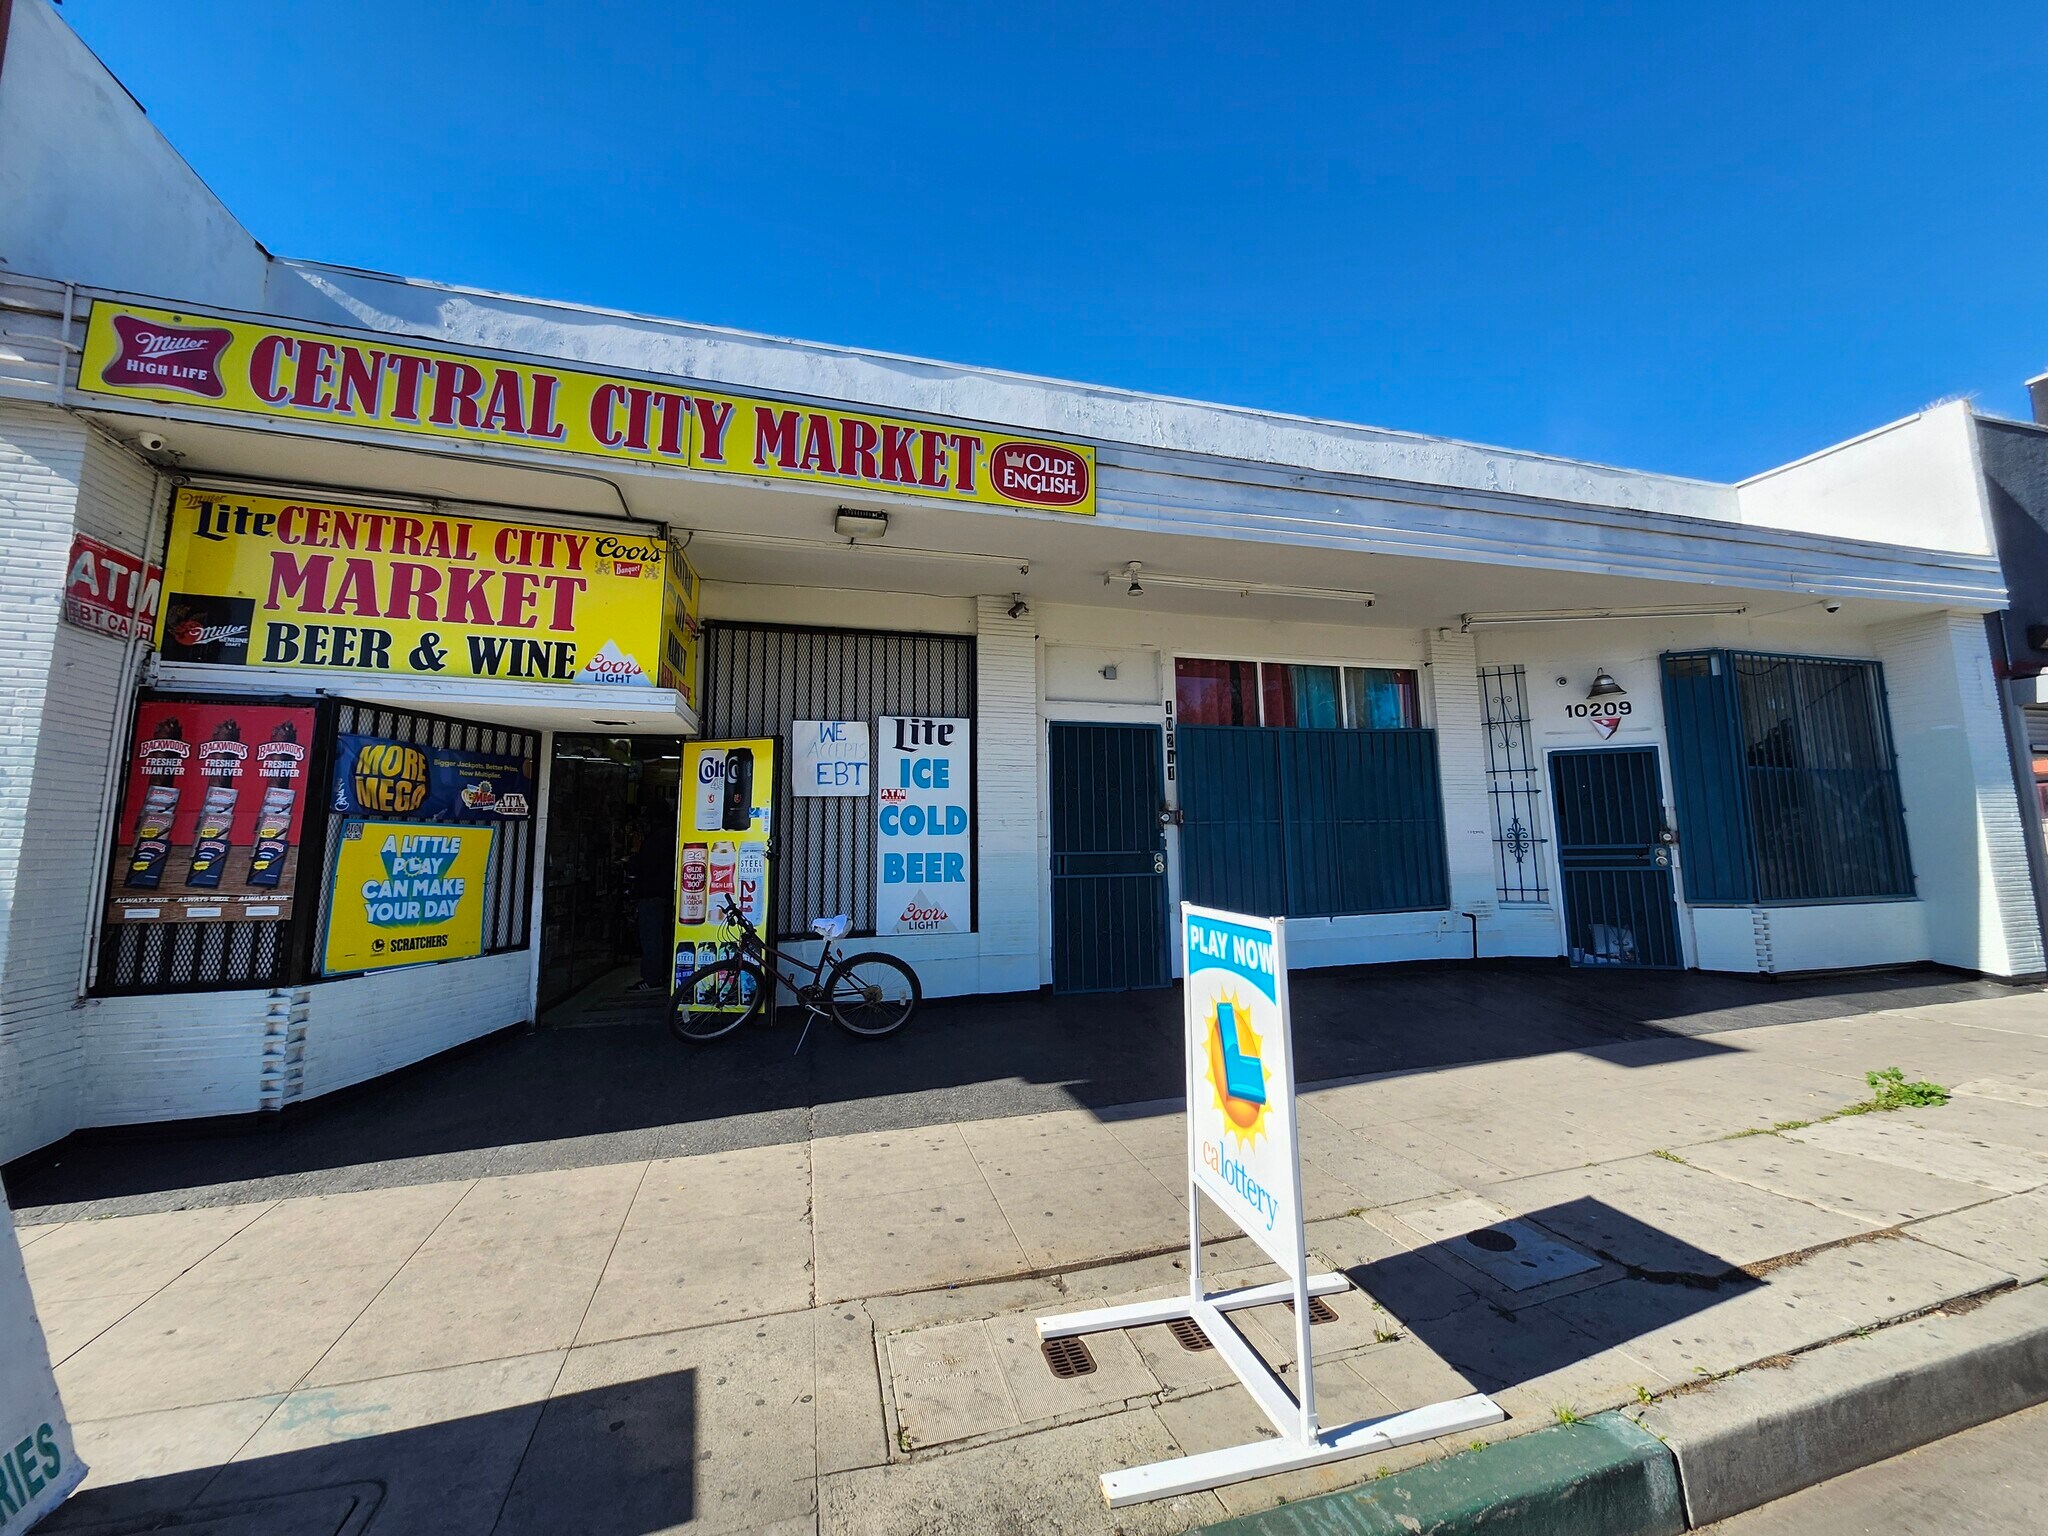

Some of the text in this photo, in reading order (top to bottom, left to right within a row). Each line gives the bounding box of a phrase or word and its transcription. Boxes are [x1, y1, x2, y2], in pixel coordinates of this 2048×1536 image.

[135, 331, 210, 360] Miller
[126, 360, 209, 381] HIGH LIFE
[248, 335, 982, 492] CENTRAL CITY MARKET
[1025, 453, 1076, 477] OLDE
[1003, 468, 1077, 495] ENGLISH
[179, 493, 227, 510] Miller
[193, 501, 276, 541] Lite
[276, 505, 590, 570] CENTRAL CITY
[595, 536, 661, 563] Coors
[616, 562, 640, 576] Banquet
[263, 551, 587, 632] MARKET
[189, 625, 248, 645] Miller
[262, 622, 577, 680] BEER & WINE
[585, 653, 644, 676] Coors
[594, 673, 632, 685] LIGHT
[1564, 701, 1633, 719] 10209
[819, 722, 847, 743] WE
[892, 718, 954, 752] Lite
[140, 739, 190, 758] BACKWOODS
[199, 741, 248, 760] BACKWOODS
[257, 742, 304, 761] BACKWOODS
[141, 766, 184, 776] THAN EVER
[145, 758, 182, 767] FRESHER
[200, 768, 243, 777] THAN EVER
[205, 759, 241, 768] FRESHER
[263, 760, 297, 769] FRESHER
[355, 745, 426, 782] MORE
[699, 757, 724, 784] Colt
[900, 758, 949, 788] ICE
[259, 769, 299, 778] THAN EVER
[816, 761, 868, 786] EBT
[355, 776, 426, 812] MEGA
[882, 789, 905, 797] ATM
[879, 805, 968, 836] COLD
[381, 835, 461, 854] A LITTLE
[687, 851, 702, 860] 24
[392, 857, 444, 877] PLAY
[883, 853, 966, 884] BEER
[361, 879, 465, 899] CAN MAKE
[739, 880, 756, 912] 211
[364, 899, 460, 922] YOUR DAY
[899, 902, 949, 922] Coors
[908, 921, 940, 930] LIGHT
[390, 934, 449, 953] SCRATCHERS
[1190, 924, 1275, 976] PLAY NOW
